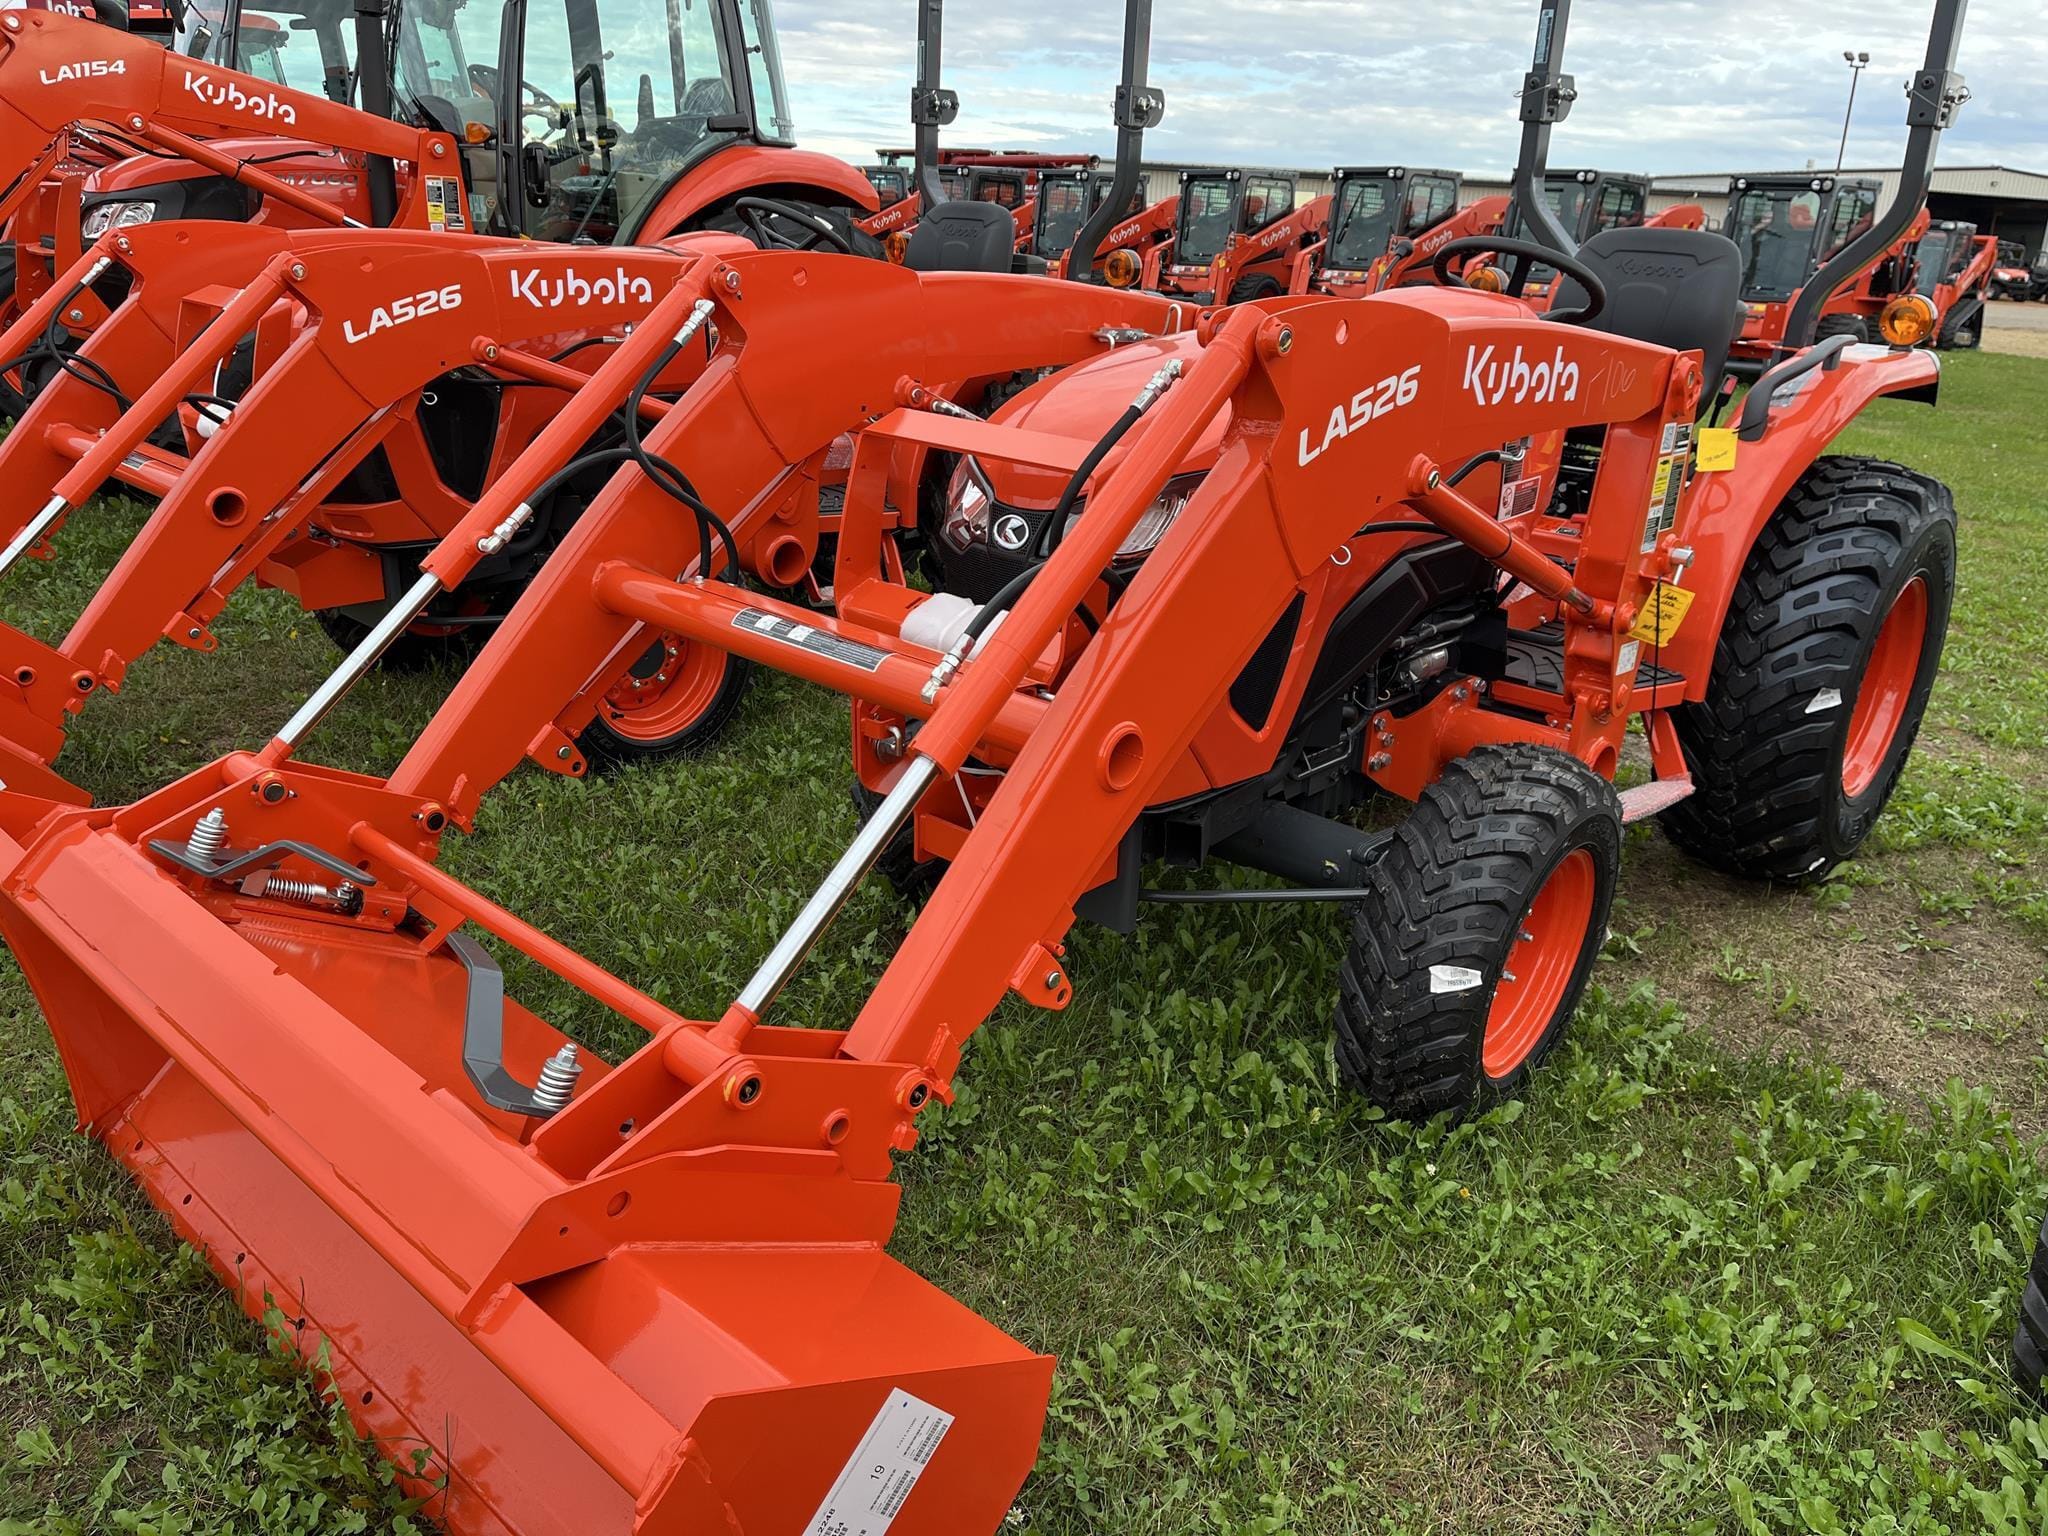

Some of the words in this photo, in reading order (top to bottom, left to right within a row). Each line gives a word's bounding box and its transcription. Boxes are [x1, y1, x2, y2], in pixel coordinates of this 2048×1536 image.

[39, 59, 126, 85] LA1154
[183, 71, 296, 125] Kubota
[872, 210, 901, 229] Kubota
[1110, 223, 1140, 243] Kubota
[1261, 226, 1291, 247] Kubota
[1422, 229, 1453, 252] Kubota
[510, 267, 652, 308] Kubota
[342, 284, 462, 344] LA526
[1463, 345, 1580, 406] Kubota
[1298, 364, 1421, 467] LA526
[870, 1464, 886, 1481] 19
